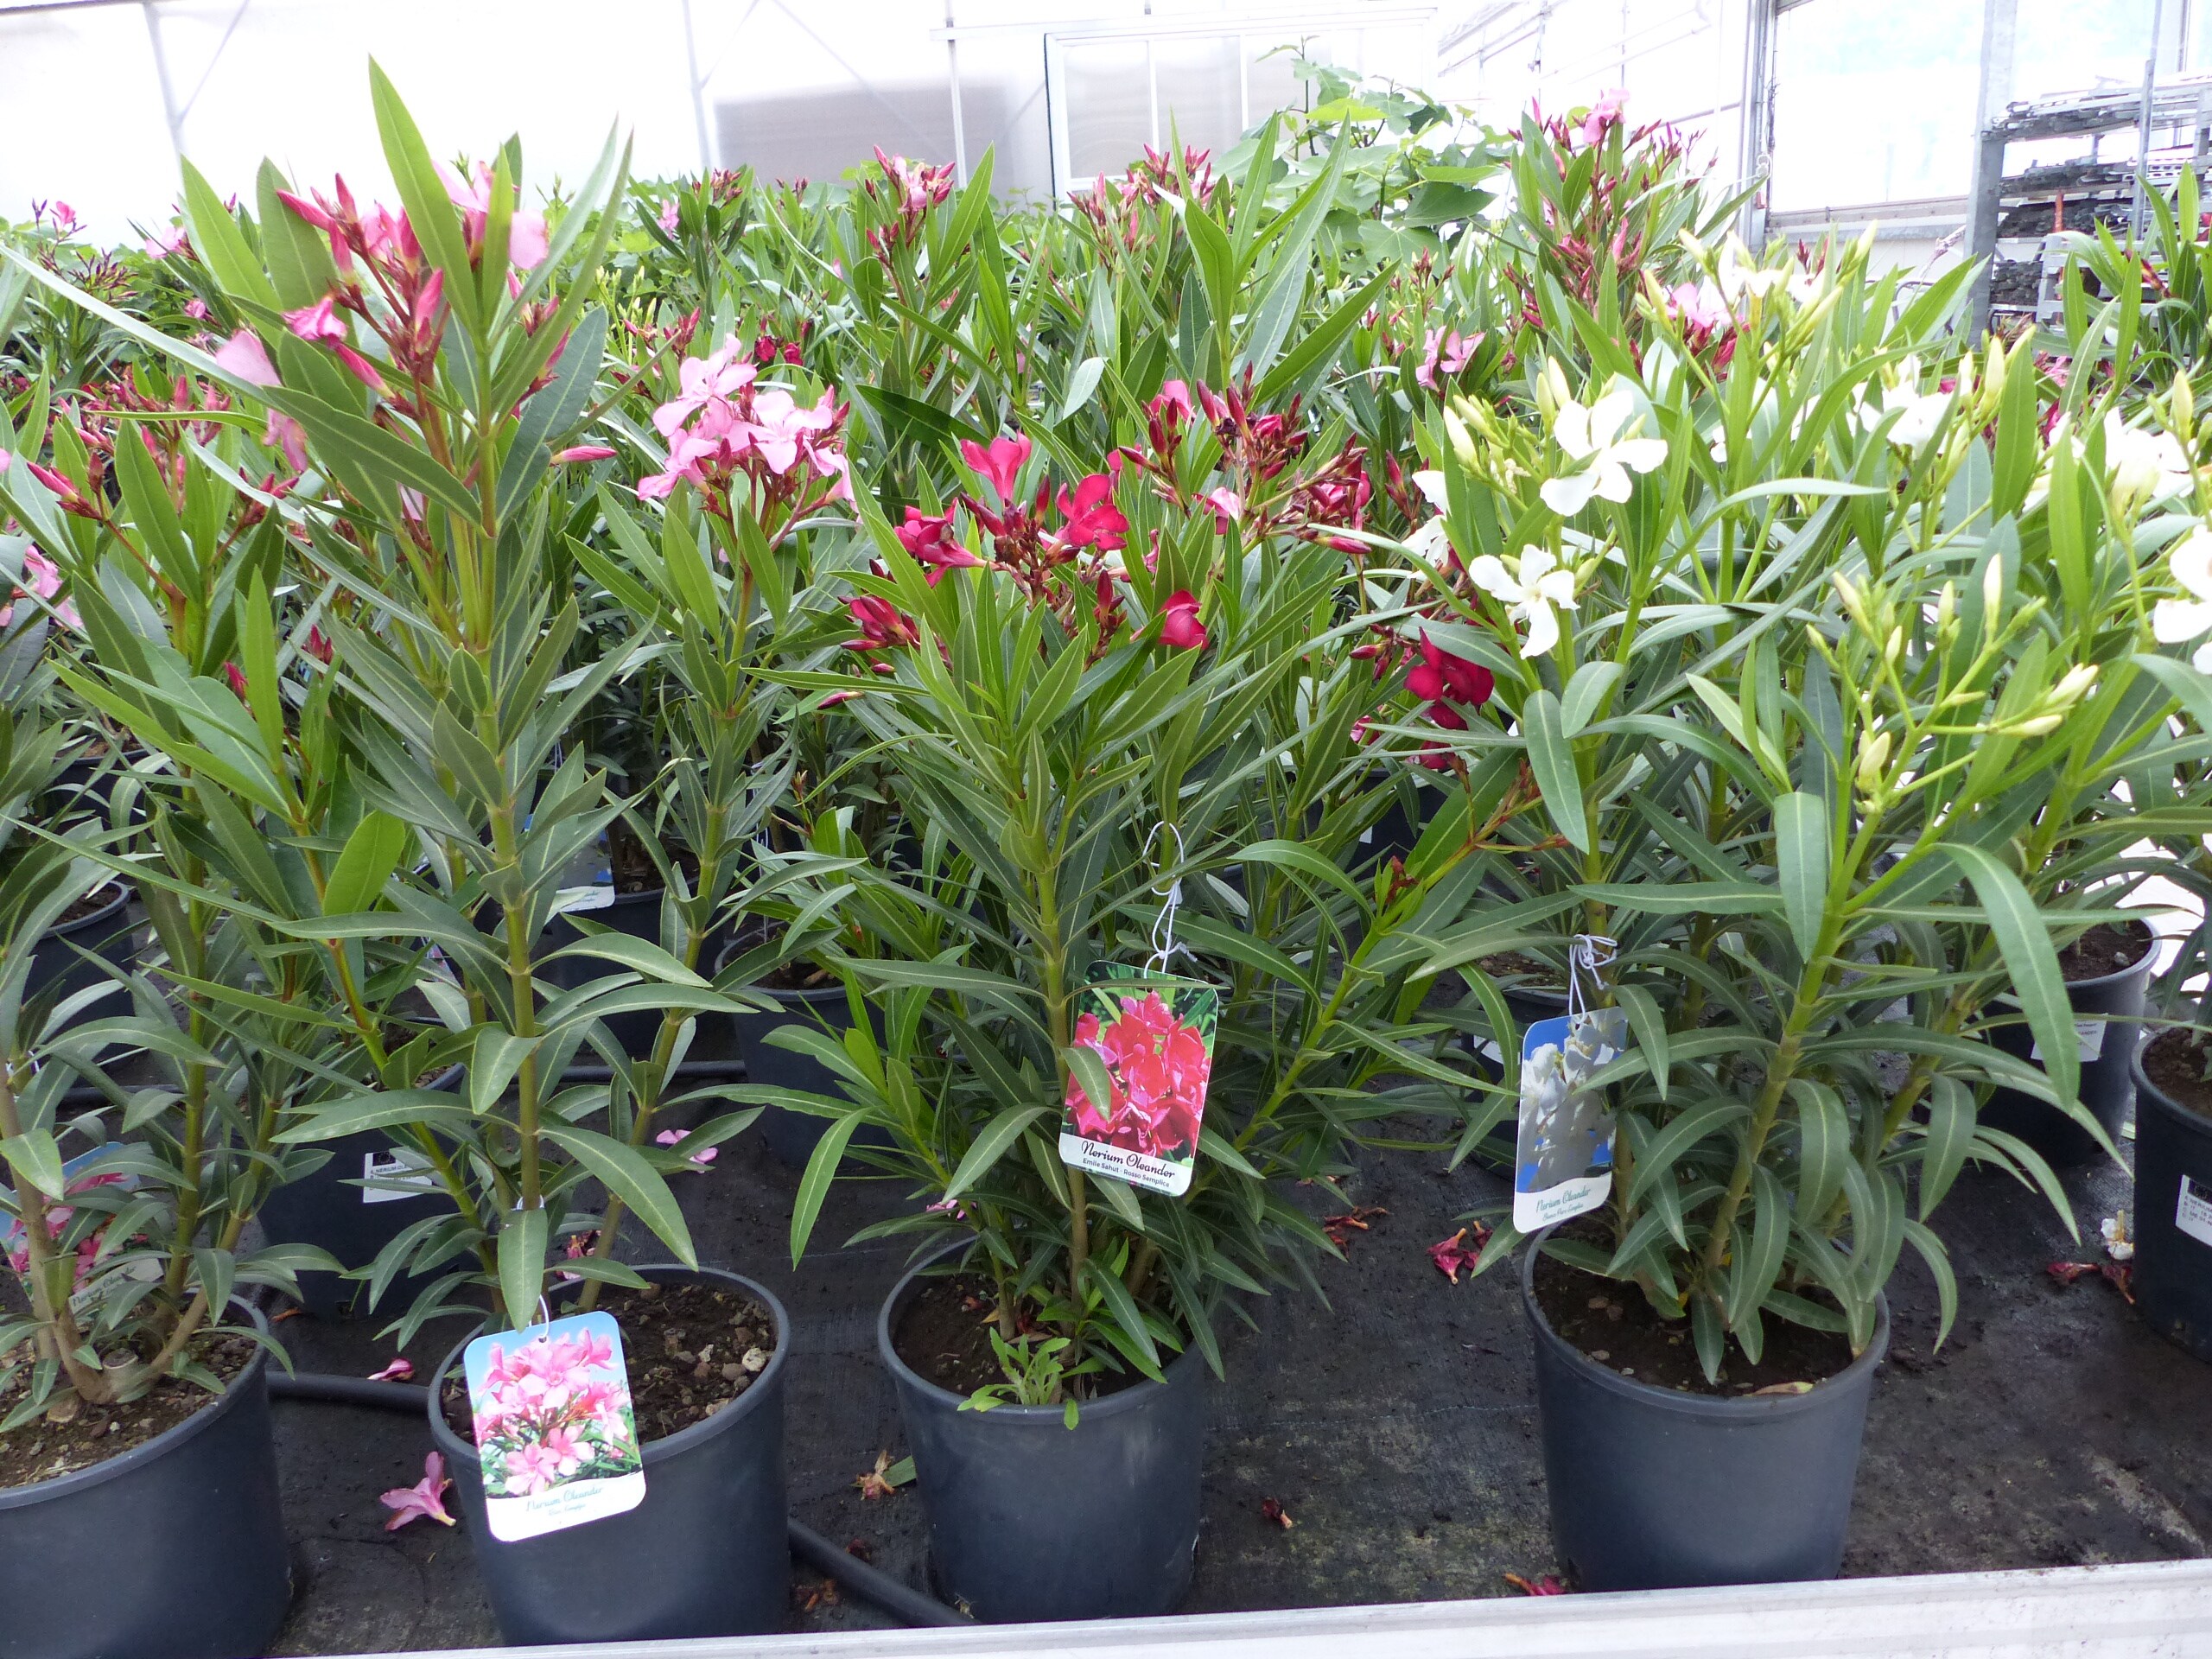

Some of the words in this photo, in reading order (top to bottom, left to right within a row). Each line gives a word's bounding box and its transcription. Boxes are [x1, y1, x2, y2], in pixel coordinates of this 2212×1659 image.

[1081, 1141, 1123, 1165] Nerium
[1126, 1154, 1175, 1179] Oleander
[1083, 1158, 1101, 1167] Emile
[1101, 1162, 1120, 1173] Sahut
[1123, 1168, 1141, 1179] Rosso
[1141, 1174, 1170, 1188] Semplice
[525, 1498, 562, 1512] Nerium
[563, 1486, 604, 1503] Oleander
